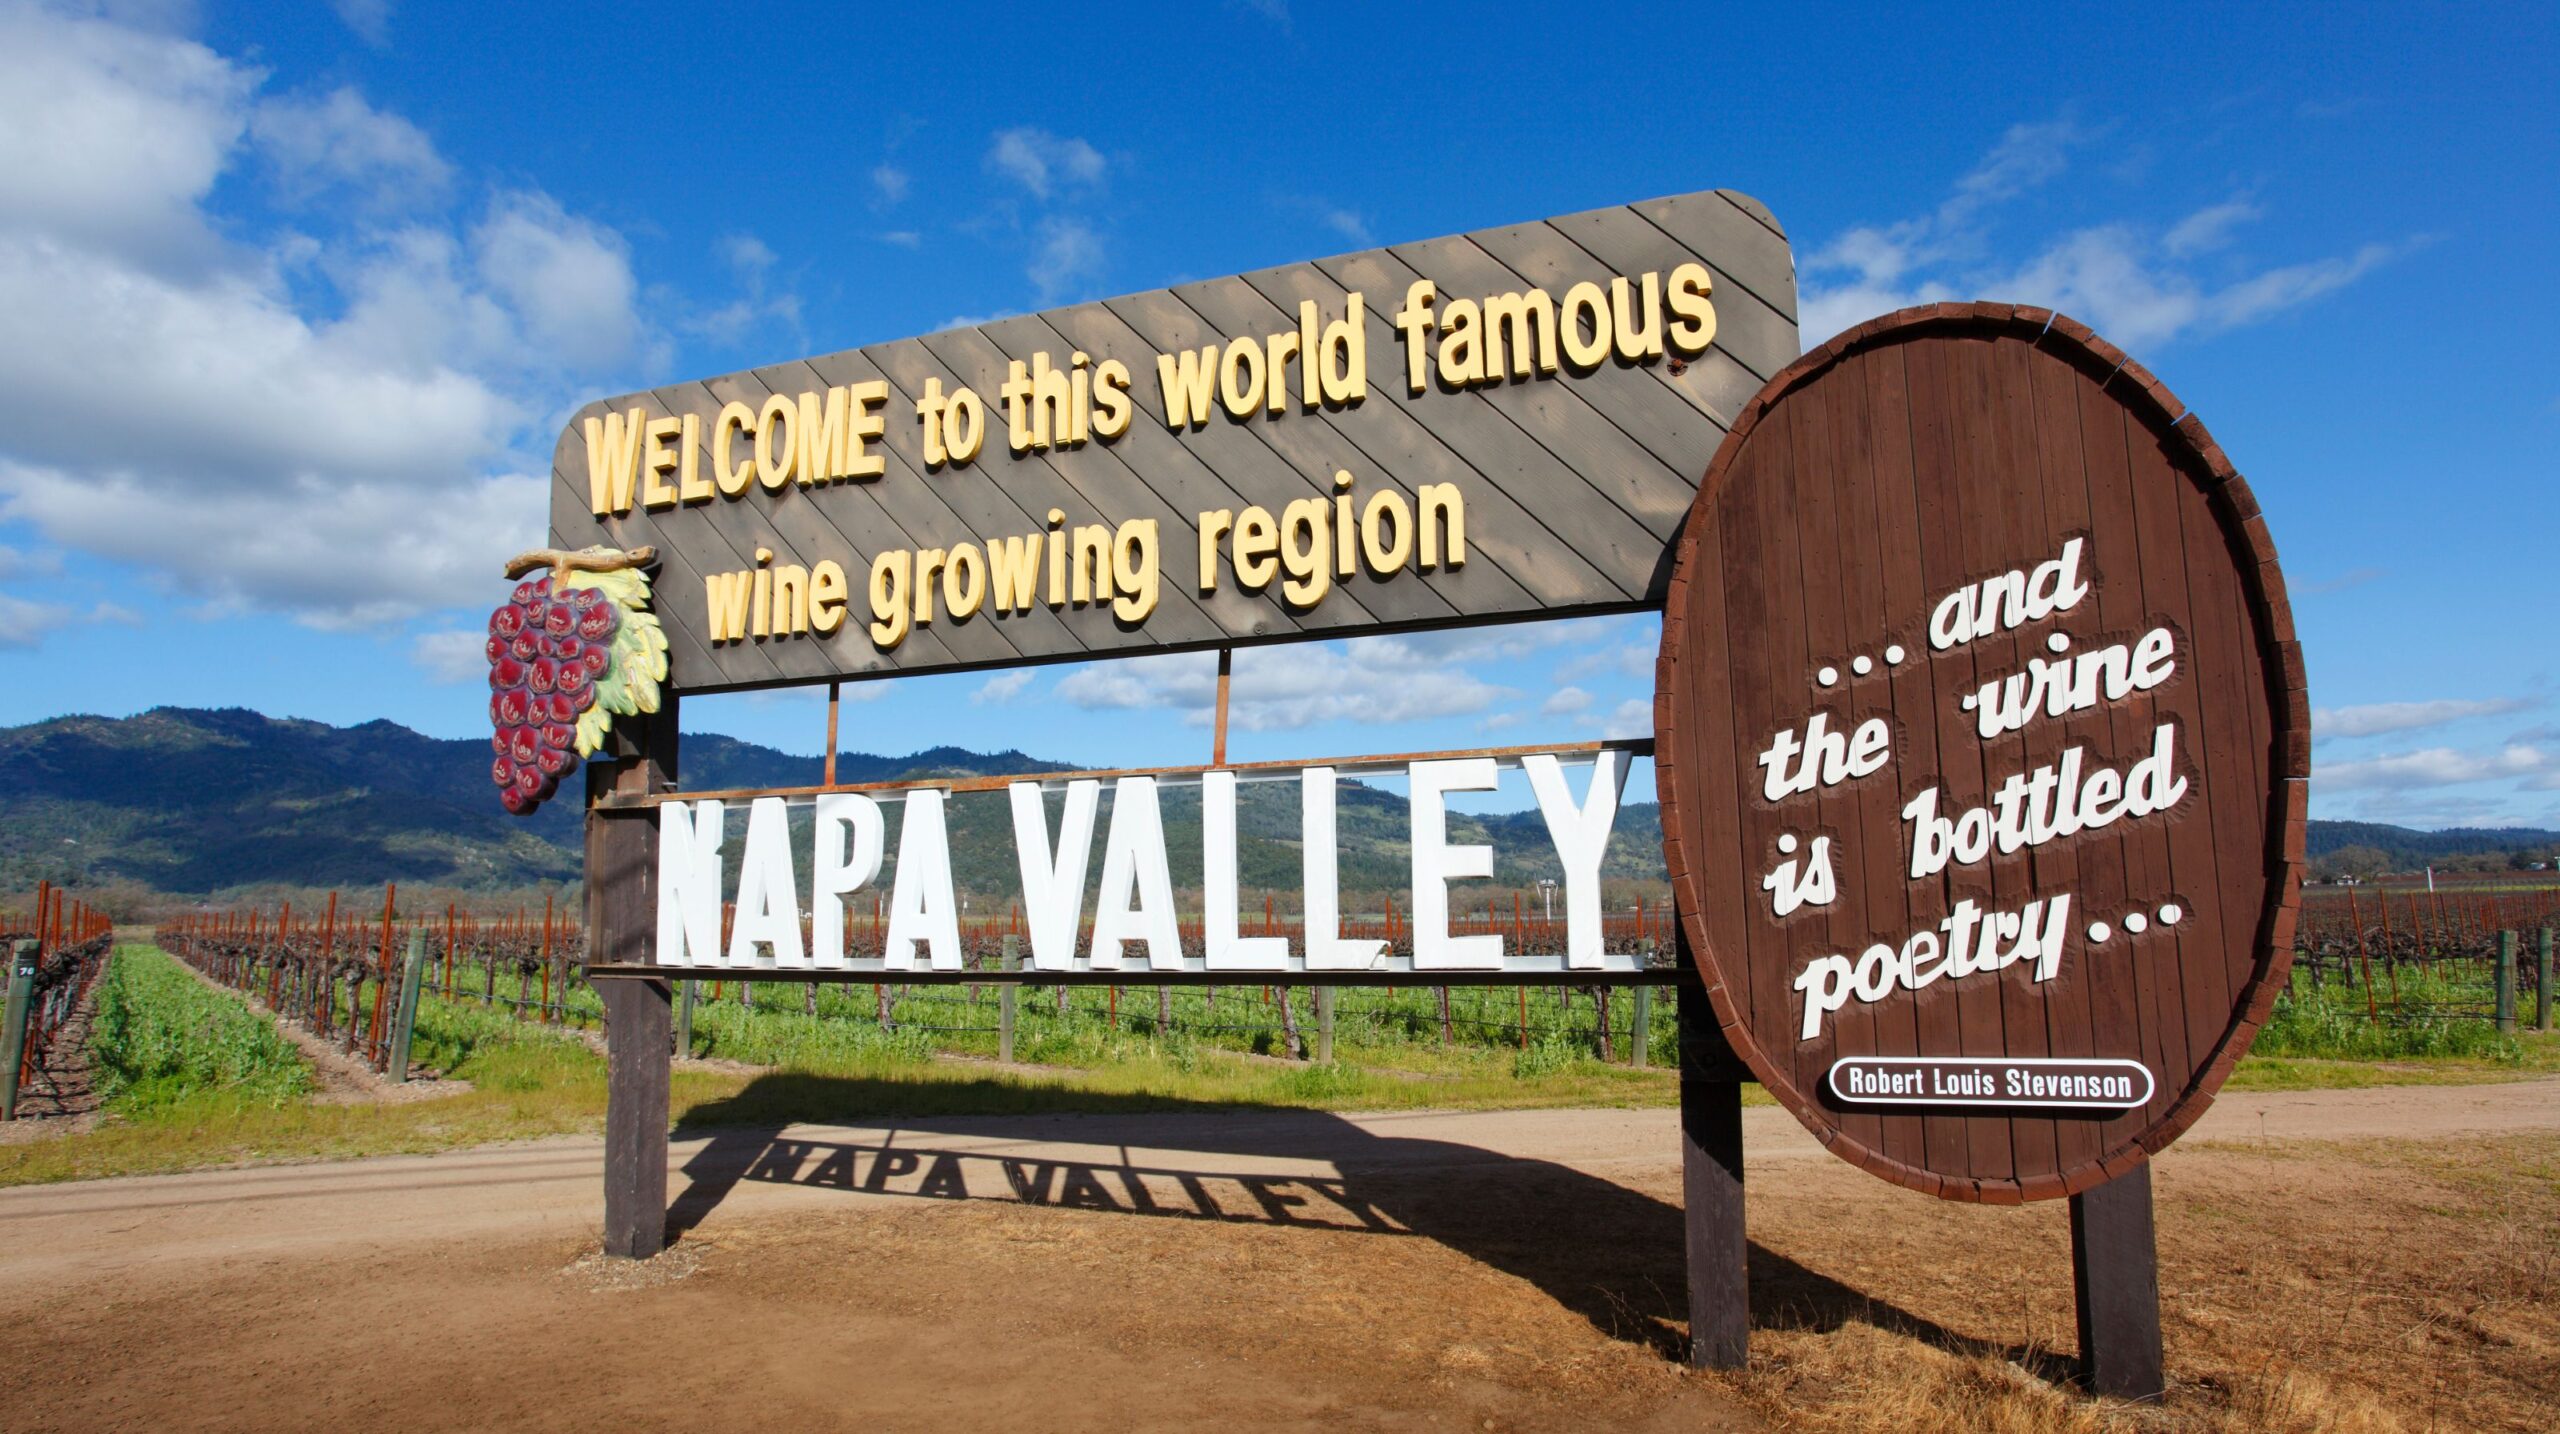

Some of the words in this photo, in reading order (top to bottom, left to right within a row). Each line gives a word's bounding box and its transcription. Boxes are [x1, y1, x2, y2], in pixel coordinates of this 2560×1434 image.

[583, 378, 889, 515] WELCOME
[915, 376, 985, 466] to
[999, 350, 1132, 452] this
[1157, 291, 1368, 428] world
[1395, 262, 1718, 392] famous
[706, 546, 849, 642] wine
[868, 507, 1160, 647] growing
[1198, 468, 1467, 608] region
[1758, 711, 1891, 803] the
[1962, 626, 2176, 740] wine
[656, 785, 963, 972] NAPA
[1008, 750, 1634, 972] VALLEY
[1762, 832, 1837, 917] is
[1901, 723, 2189, 880] bottled
[1849, 1066, 1925, 1095] Robert
[1933, 1067, 1996, 1097] Louis
[2005, 1068, 2133, 1098] Stevenson
